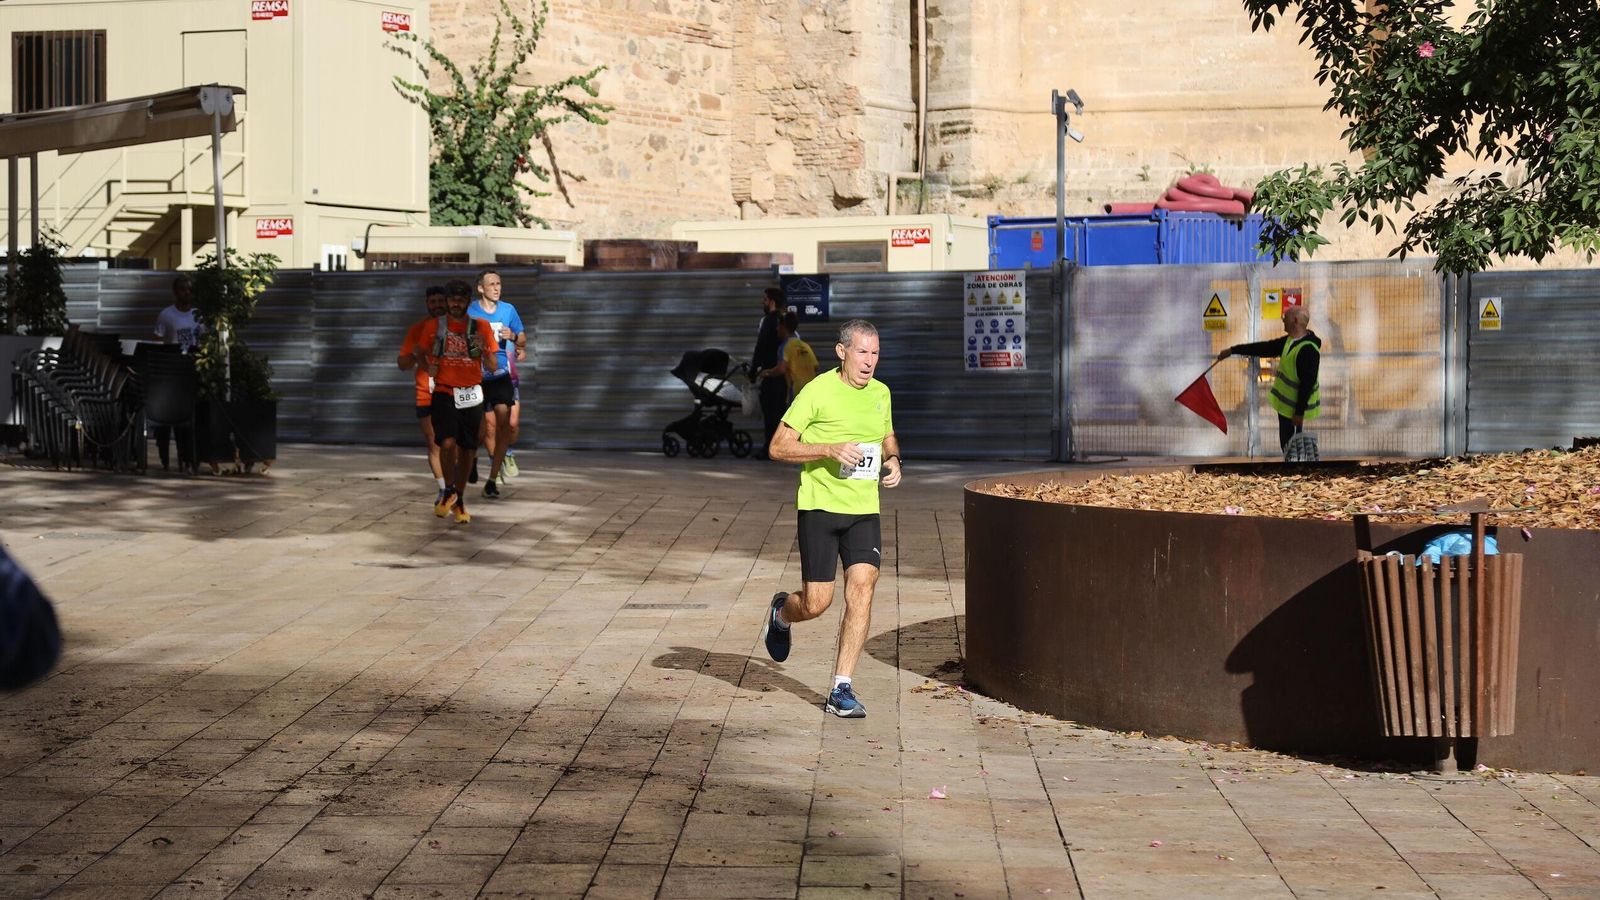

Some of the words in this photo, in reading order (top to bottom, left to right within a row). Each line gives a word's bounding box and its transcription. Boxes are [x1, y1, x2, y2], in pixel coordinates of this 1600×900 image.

[252, 1, 288, 11] REMSA
[382, 12, 410, 25] REMSA
[256, 219, 293, 230] REMSA
[892, 229, 930, 240] REMSA
[459, 393, 478, 402] 583
[854, 456, 874, 468] 87
